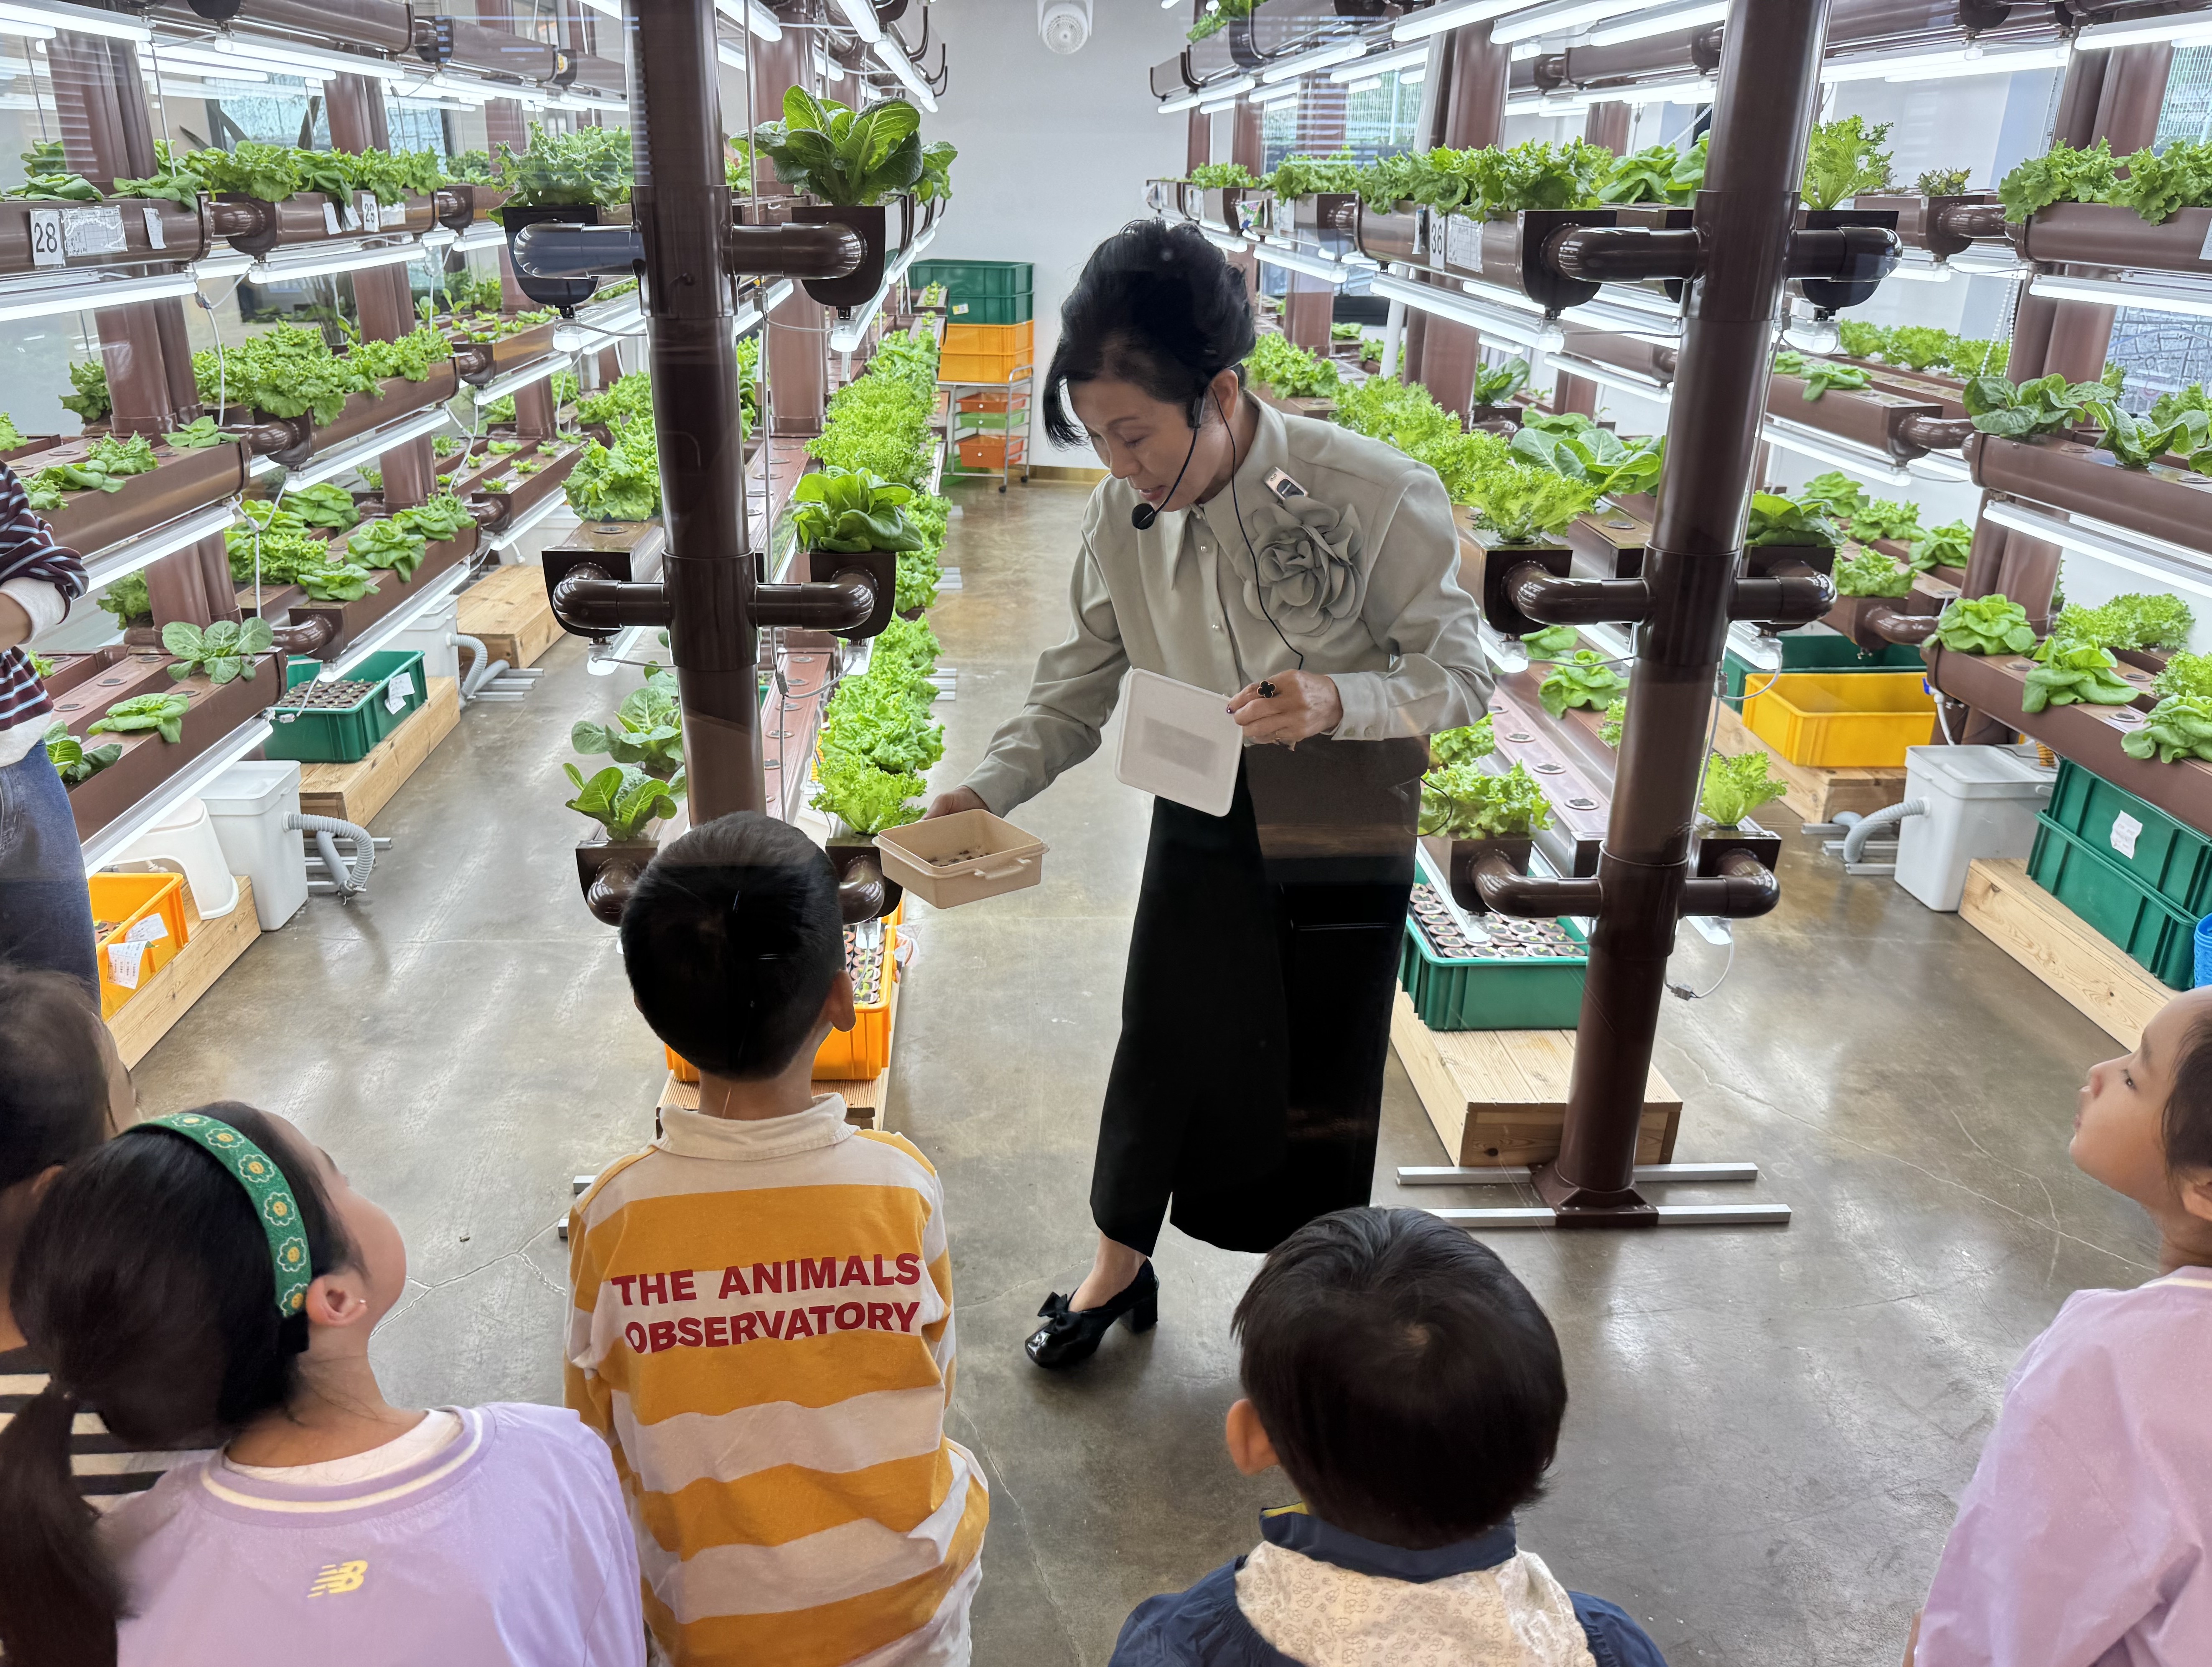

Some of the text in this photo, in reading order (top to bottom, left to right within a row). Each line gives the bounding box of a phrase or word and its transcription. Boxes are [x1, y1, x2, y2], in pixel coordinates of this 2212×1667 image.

[34, 222, 58, 253] 28
[1431, 223, 1443, 255] 36
[611, 1253, 921, 1306] THE ANIMALS
[625, 1301, 920, 1354] OBSERVATORY
